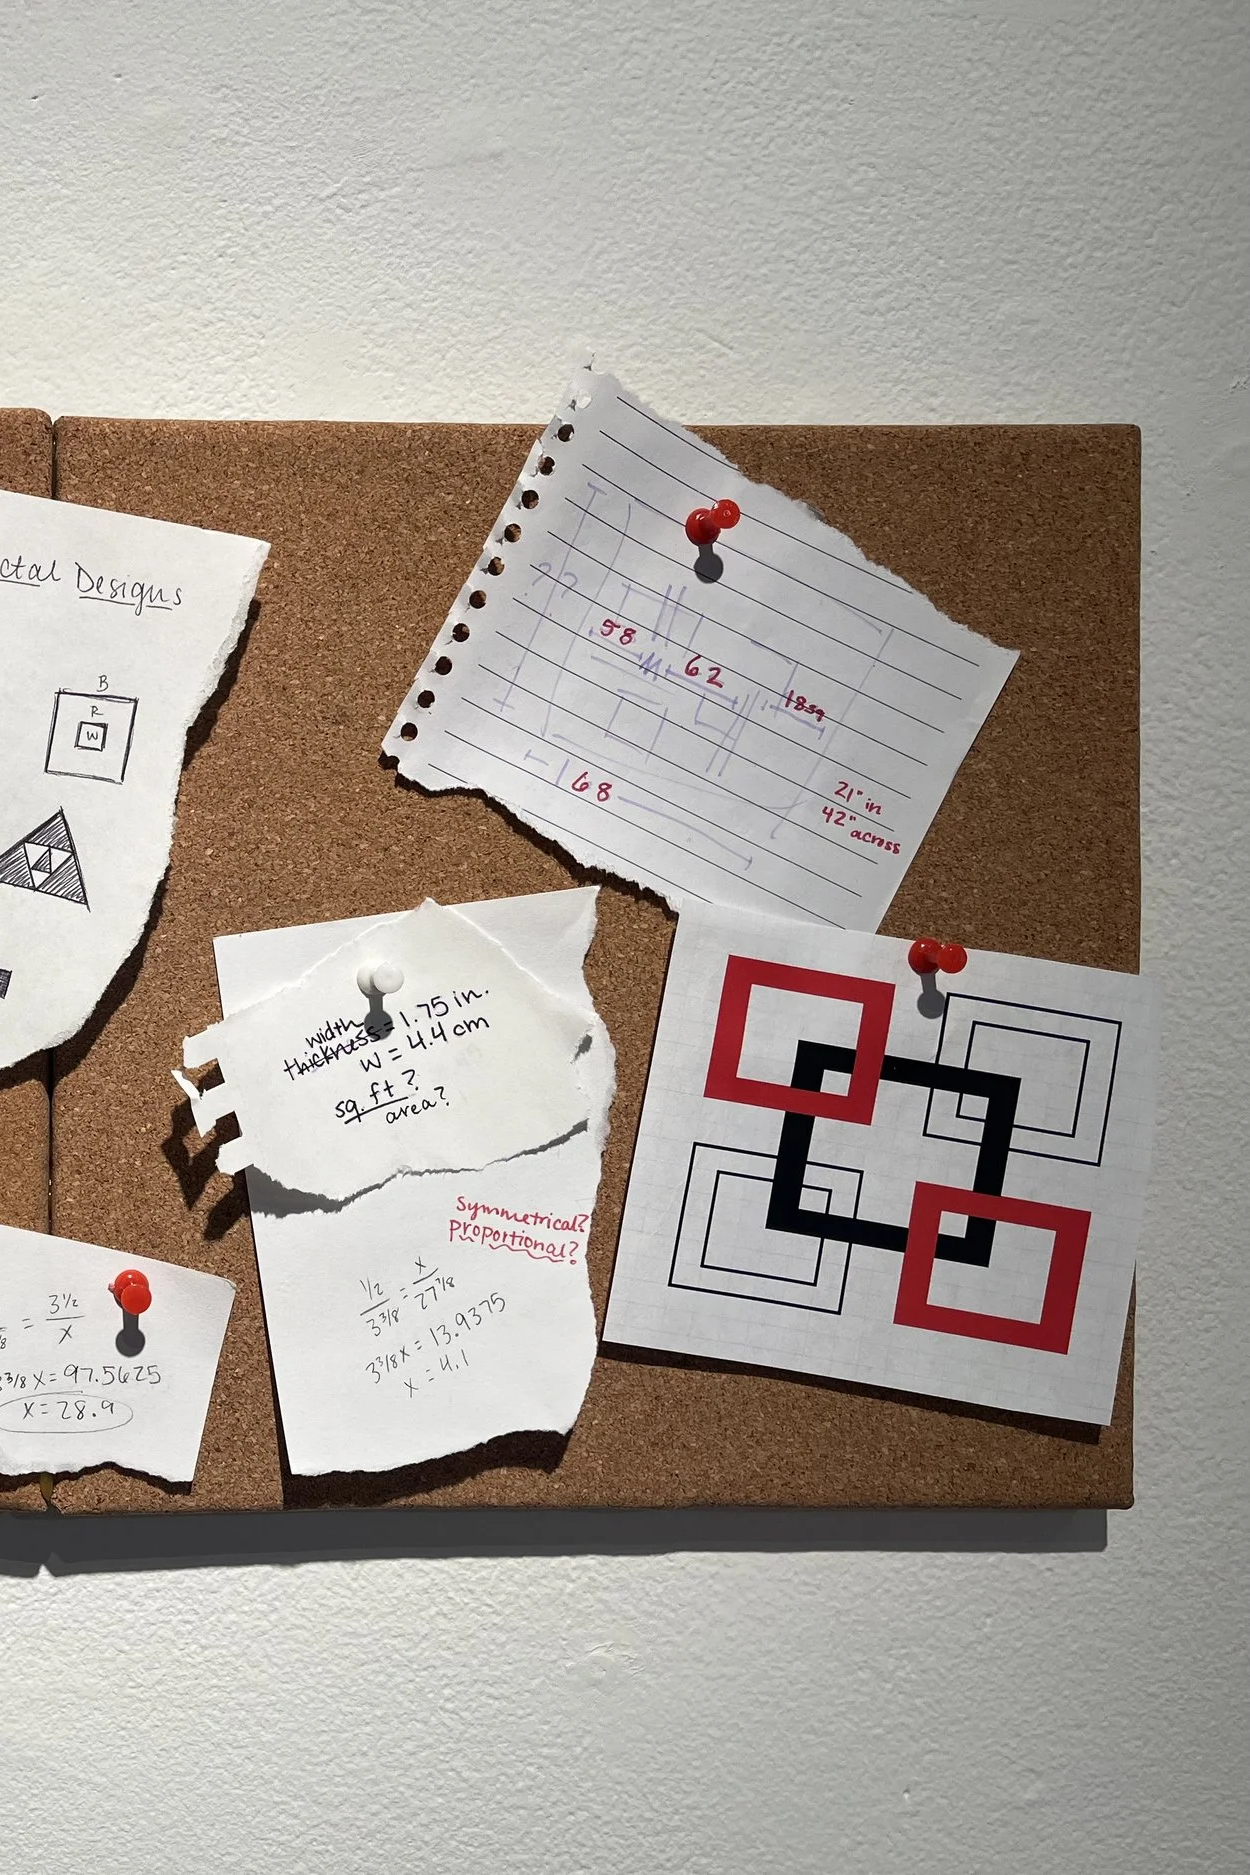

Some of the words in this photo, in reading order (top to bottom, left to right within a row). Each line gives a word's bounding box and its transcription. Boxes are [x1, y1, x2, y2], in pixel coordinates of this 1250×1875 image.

[75, 562, 182, 616] Designs
[600, 619, 637, 646] 58
[96, 674, 109, 692] B
[684, 654, 724, 689] 62
[91, 705, 104, 717] R
[865, 798, 882, 815] in
[850, 829, 901, 855] across
[399, 996, 449, 1027] 1.75
[454, 988, 490, 1009] in.
[305, 1017, 365, 1048] width
[406, 1022, 449, 1051] 4.4
[452, 1016, 490, 1037] cm
[335, 1099, 365, 1124] sq.
[386, 1085, 450, 1125] area?
[429, 1292, 506, 1347] 13.9375
[63, 1363, 161, 1386] 97.5625
[57, 1399, 115, 1421] 28.9
